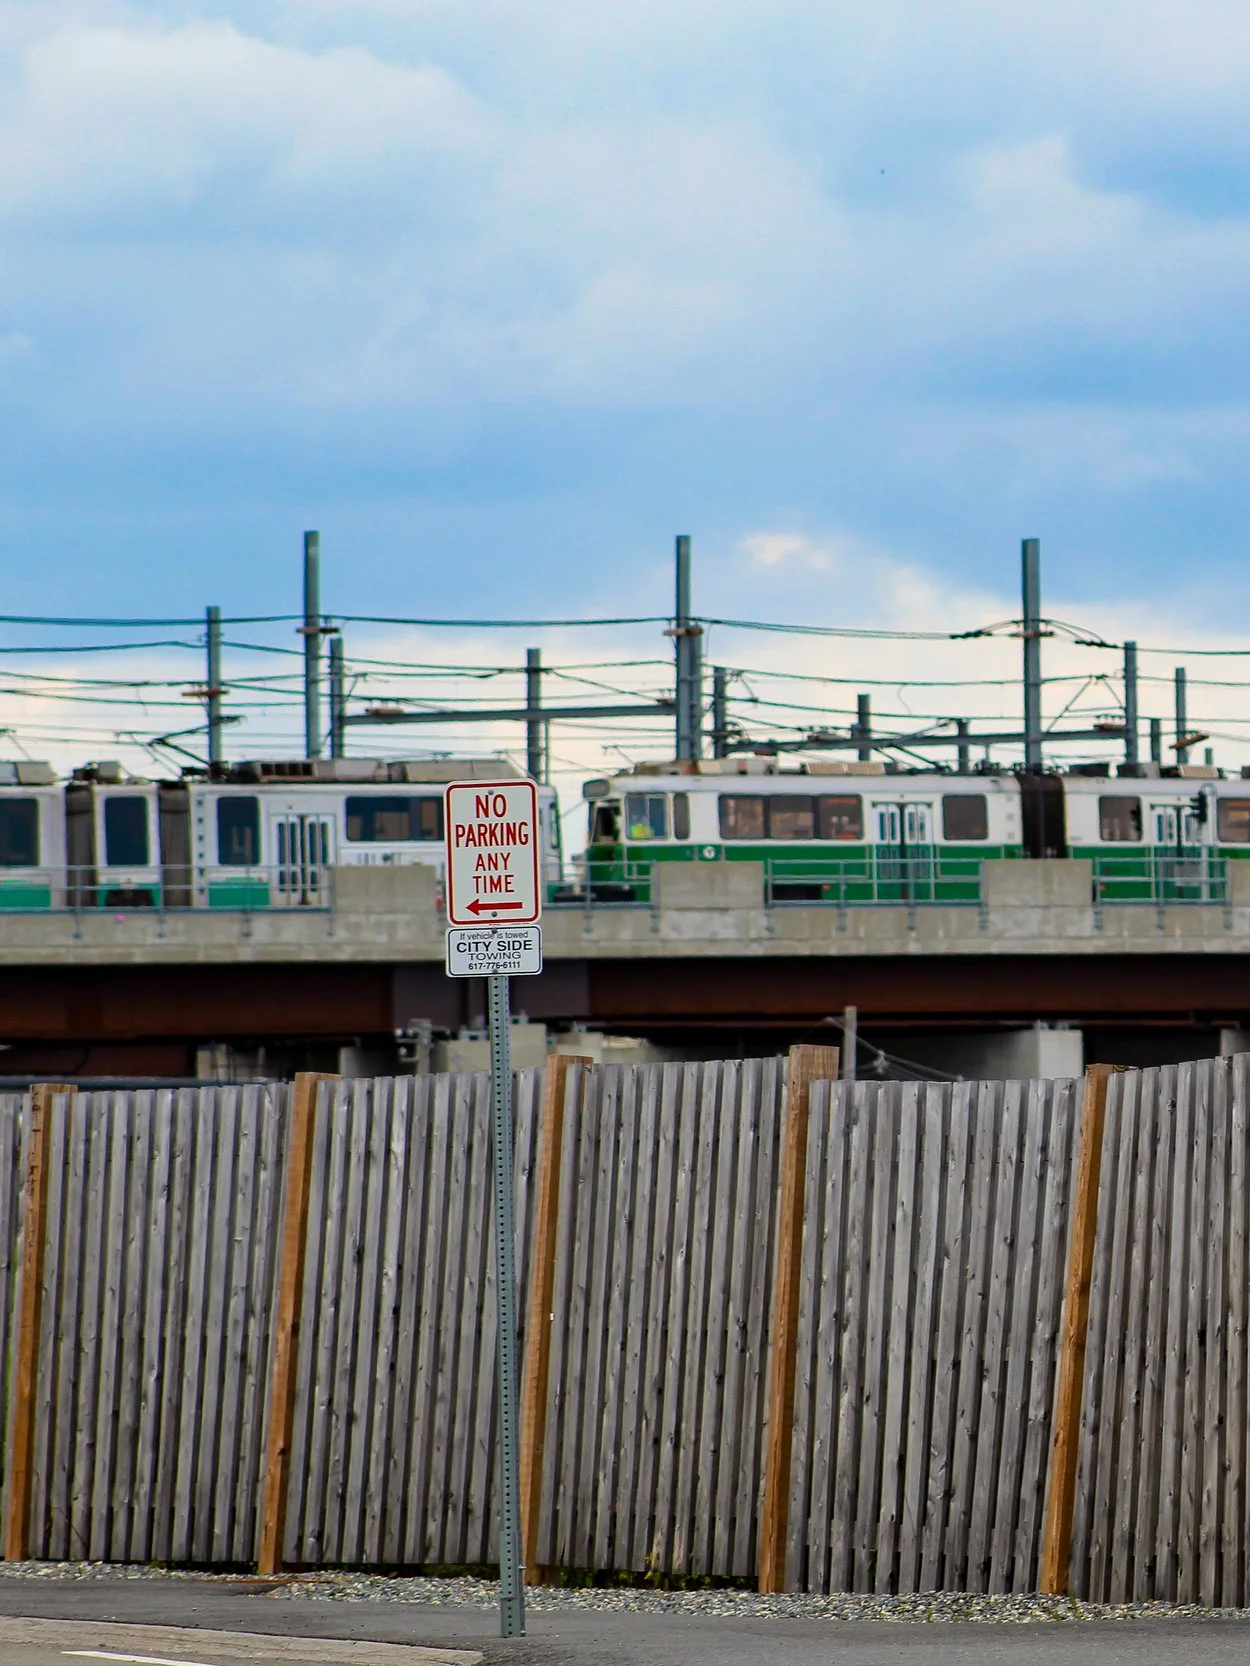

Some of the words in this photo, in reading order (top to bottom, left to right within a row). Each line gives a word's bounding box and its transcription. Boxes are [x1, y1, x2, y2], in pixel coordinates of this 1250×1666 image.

[475, 794, 507, 819] NO
[455, 821, 529, 848] PARKING
[475, 852, 511, 872] ANY
[472, 874, 515, 894] TIME
[459, 932, 465, 940] If
[467, 931, 494, 940] vehicle
[505, 930, 528, 939] towed
[456, 941, 492, 953] CITY
[497, 939, 533, 952] SIDE
[467, 951, 521, 961] TOWING
[468, 961, 521, 971] 617-776-6111
